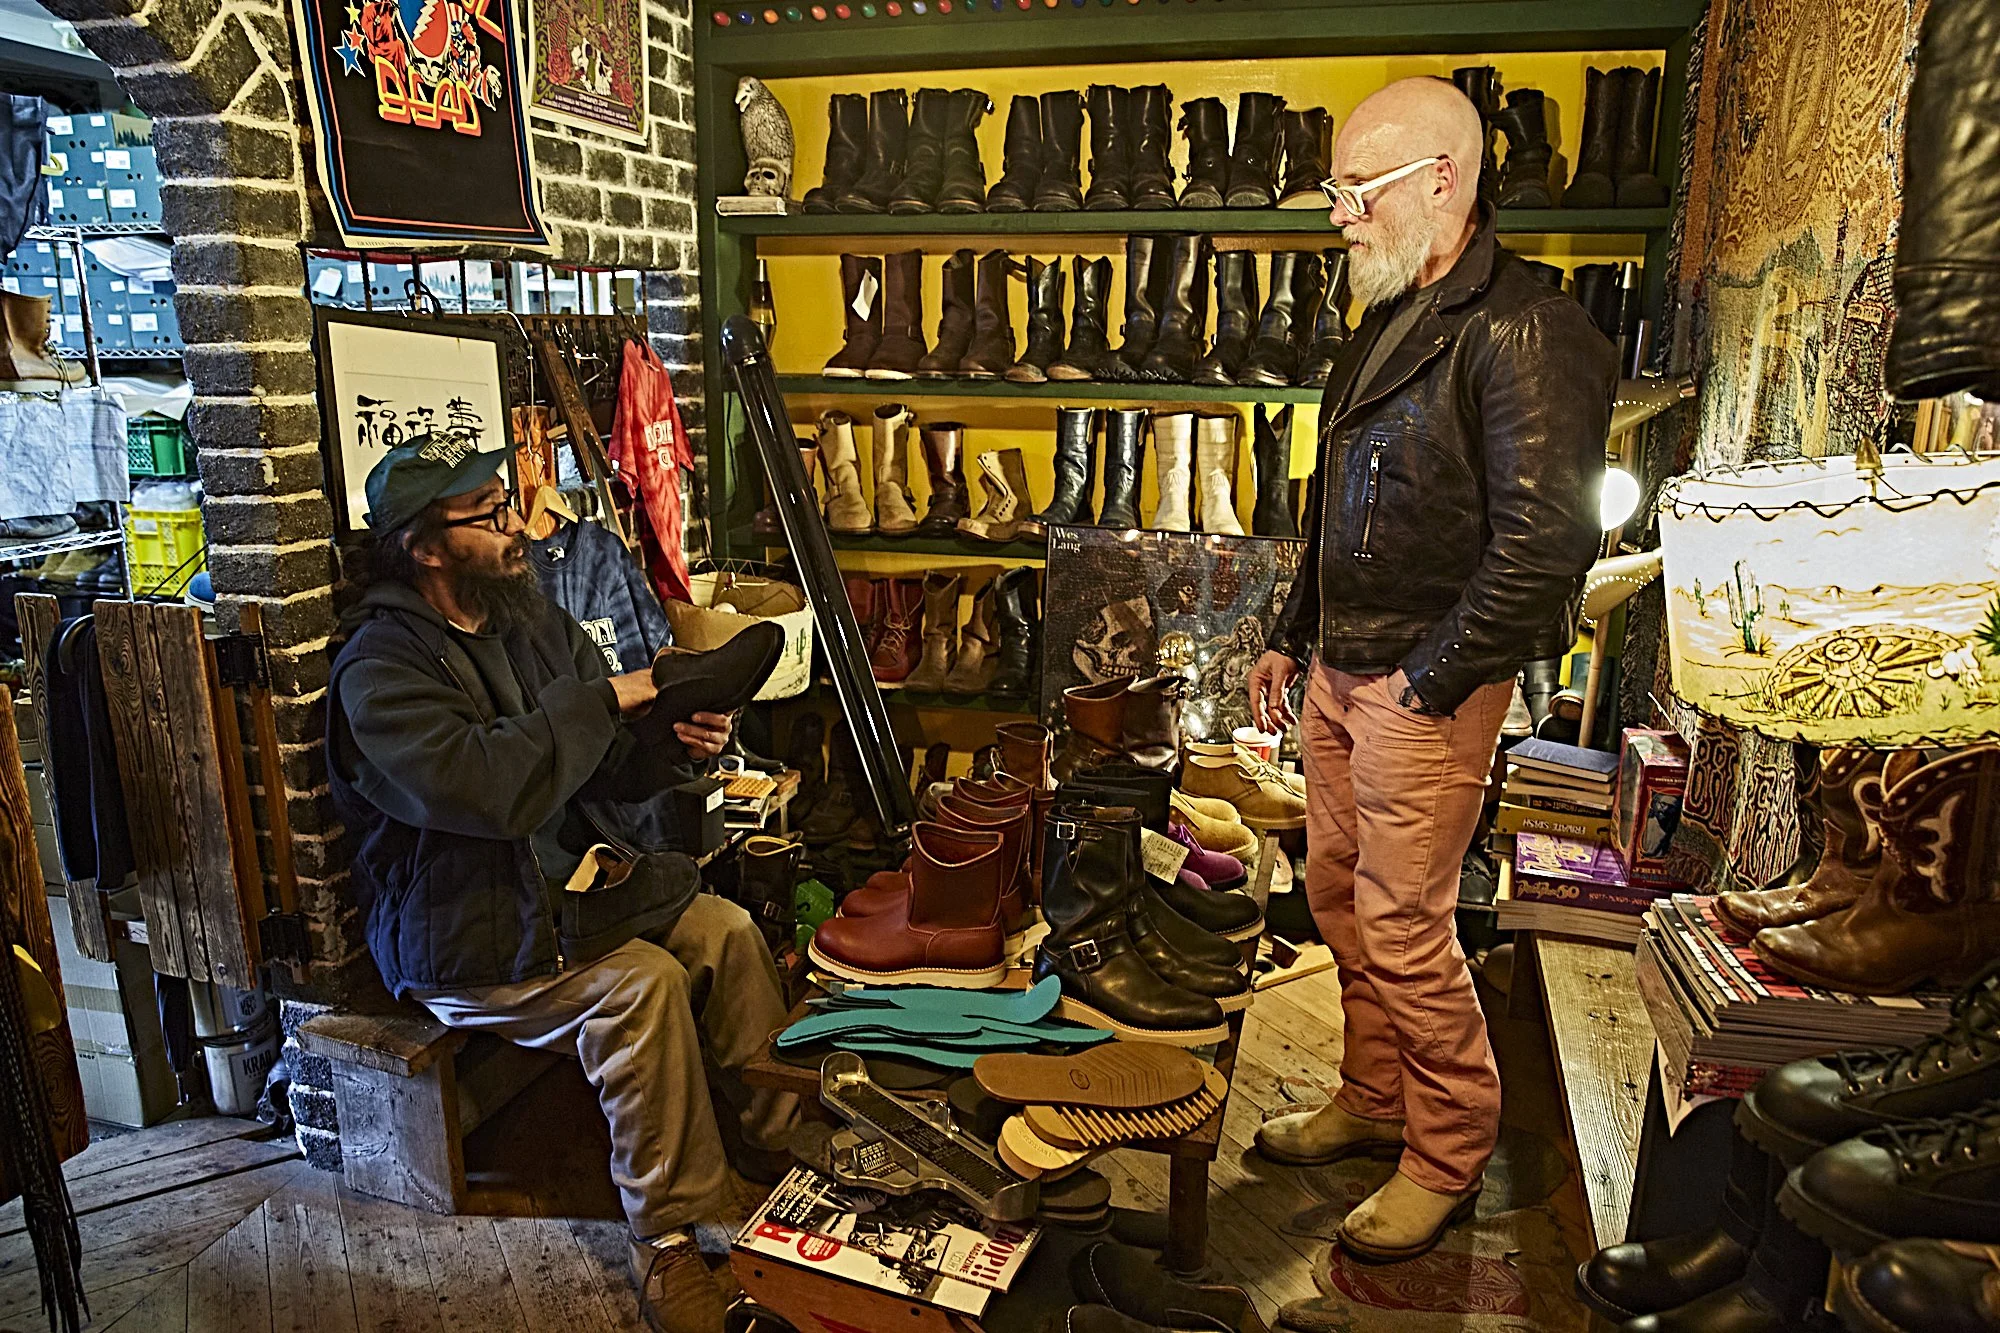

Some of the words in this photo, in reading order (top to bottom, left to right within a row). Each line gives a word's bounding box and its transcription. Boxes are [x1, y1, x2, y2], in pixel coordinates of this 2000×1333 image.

[375, 55, 482, 137] DEAD
[1055, 526, 1079, 540] Wes
[1052, 537, 1081, 554] Lang
[1522, 816, 1550, 830] STASH
[1552, 822, 1587, 835] PRIVATE
[959, 1241, 985, 1274] MAGAZINE
[970, 1228, 1026, 1282] BOP!!
